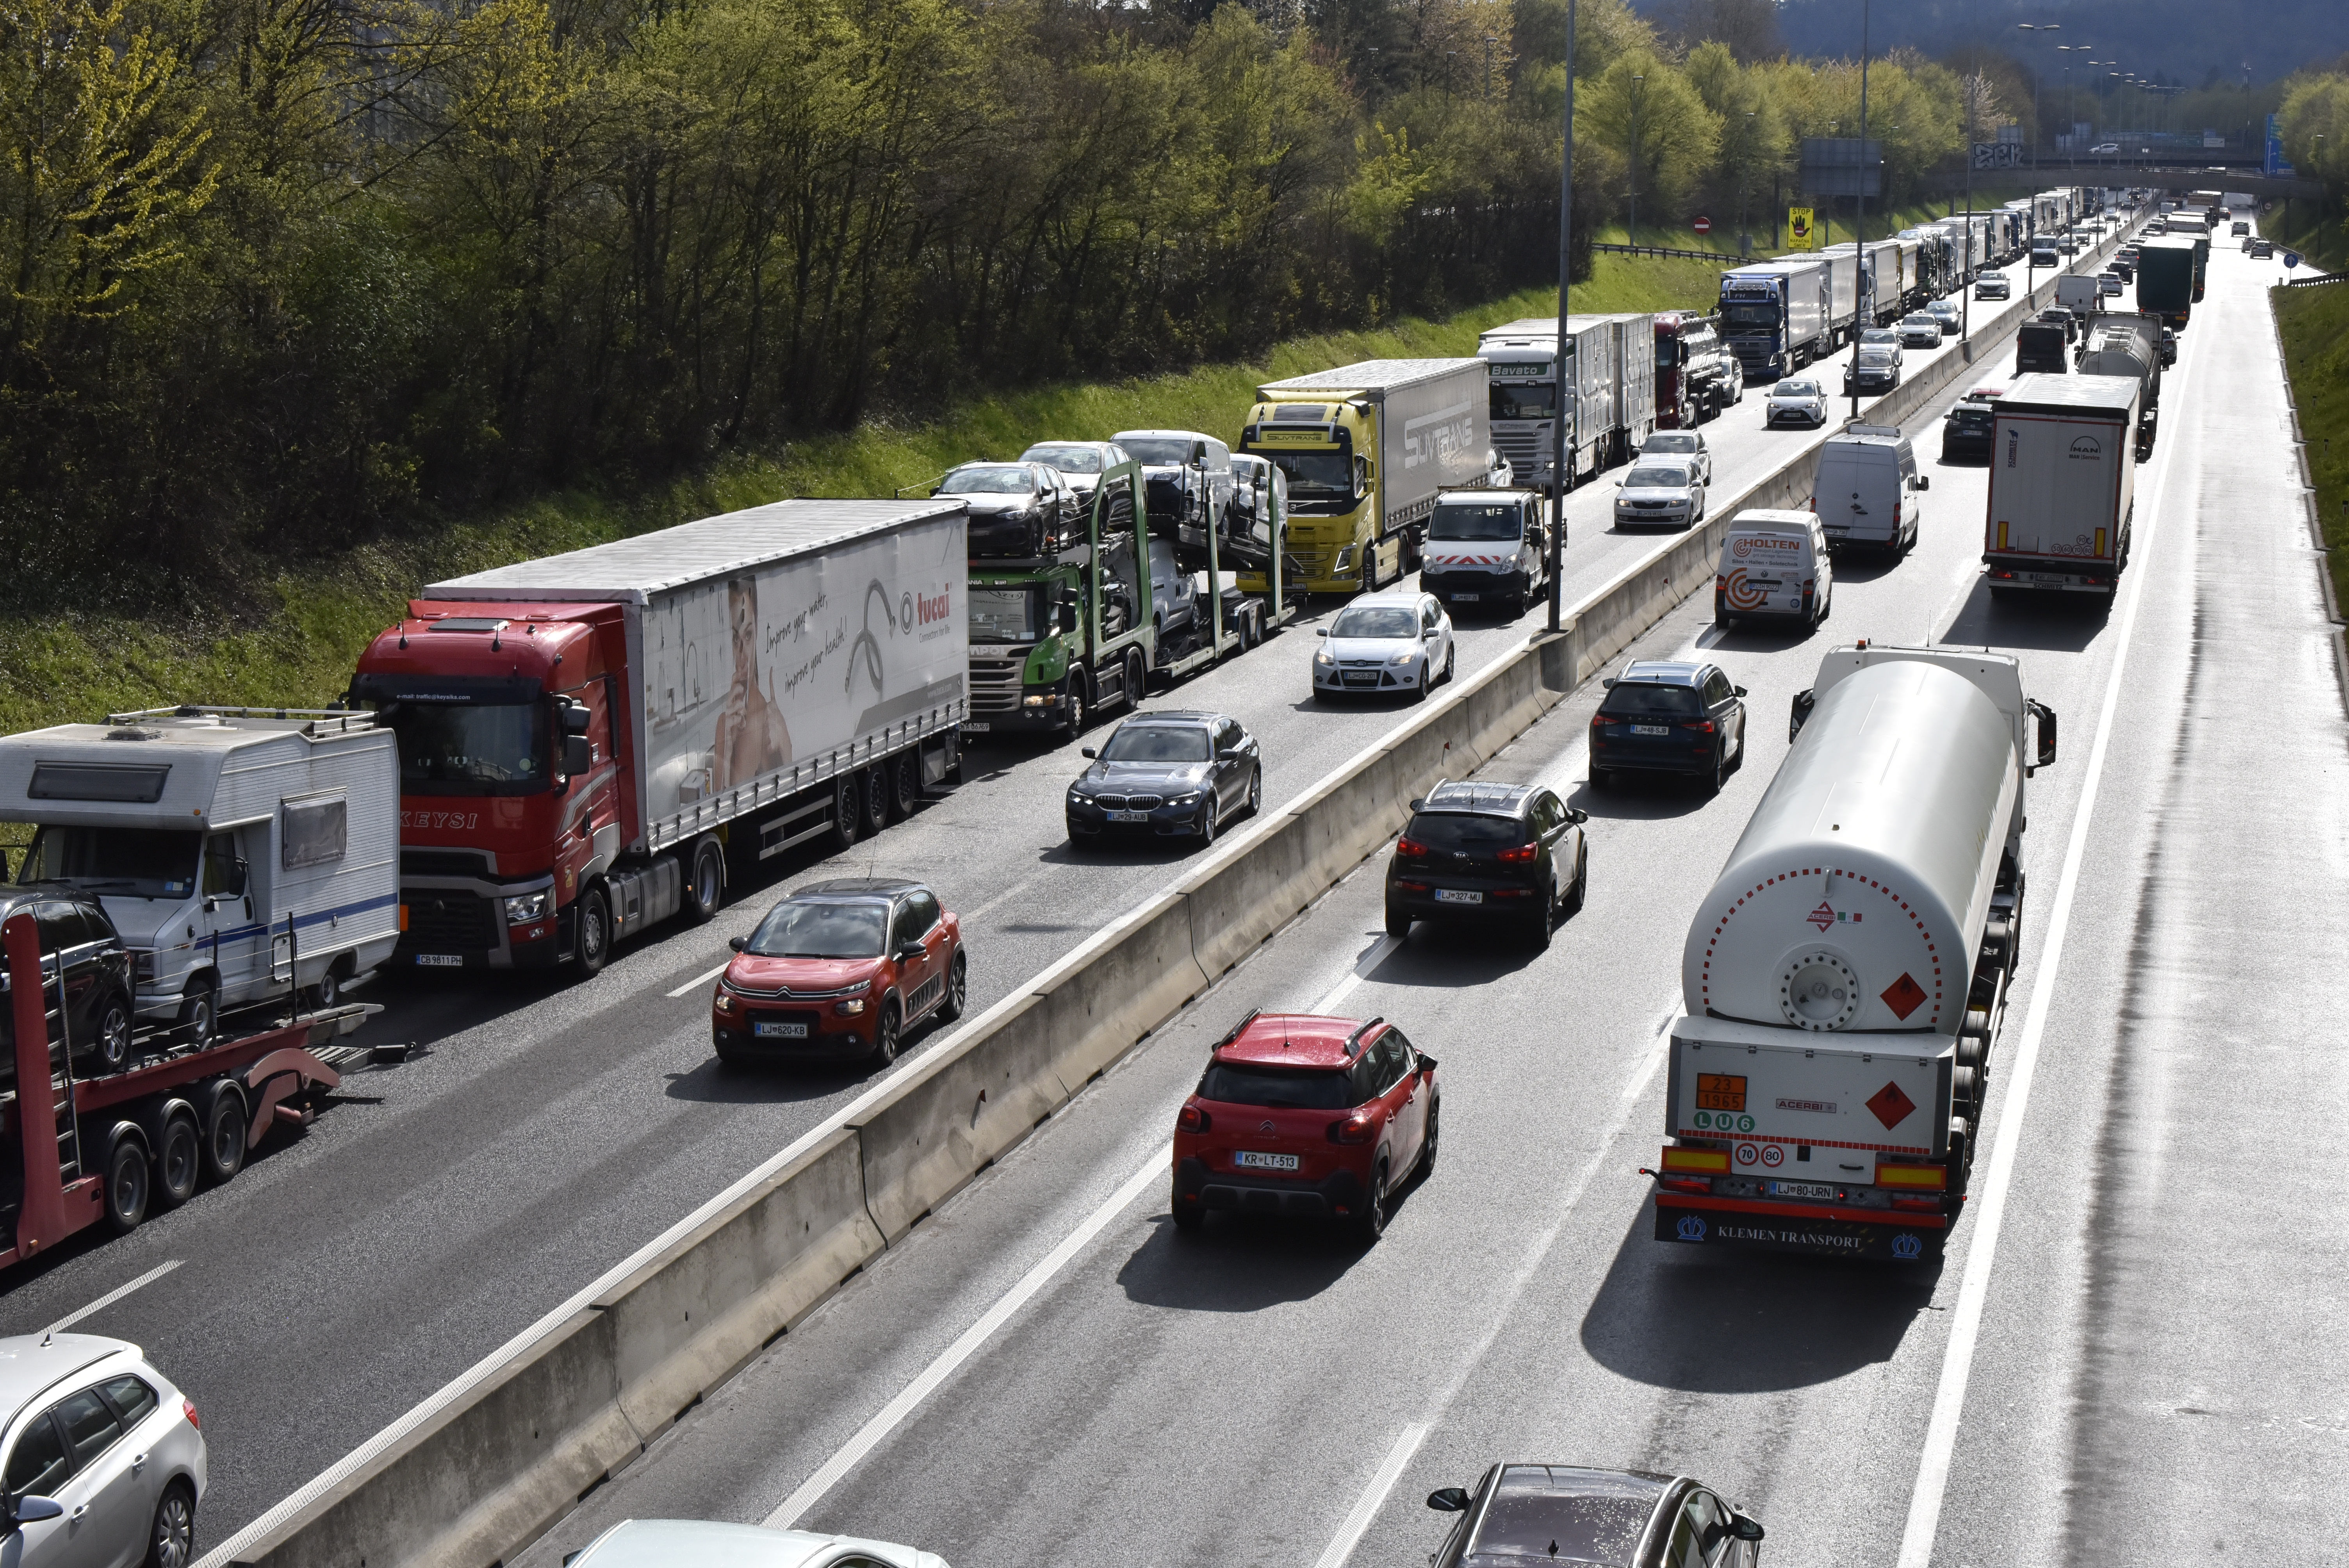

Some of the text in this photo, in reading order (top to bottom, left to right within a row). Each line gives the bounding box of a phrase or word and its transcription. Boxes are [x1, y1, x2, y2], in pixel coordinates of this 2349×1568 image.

[1492, 365, 1537, 375] Bavato
[1743, 539, 1800, 550] HOLTEN
[918, 583, 950, 626] tucai
[766, 592, 828, 658] Improve your water,
[919, 630, 939, 643] Connectors
[785, 615, 847, 700] improve your health!
[969, 646, 1006, 656] MPOL
[400, 811, 478, 829] KEYSI
[1455, 893, 1480, 901] 327-MU
[432, 956, 449, 964] 9811
[451, 957, 461, 965] PH
[762, 1025, 804, 1035] LJ 620-KB
[1713, 1078, 1731, 1090] 23
[1705, 1094, 1739, 1108] 1965
[1779, 1101, 1823, 1110] ACERBI
[1699, 1115, 1750, 1130] L U 6
[1244, 1154, 1294, 1167] KR LT-513
[1742, 1149, 1779, 1161] 70 80
[1778, 1184, 1830, 1197] LJ 80-URN
[1718, 1226, 1861, 1248] KLEMEN TRANSPORT
